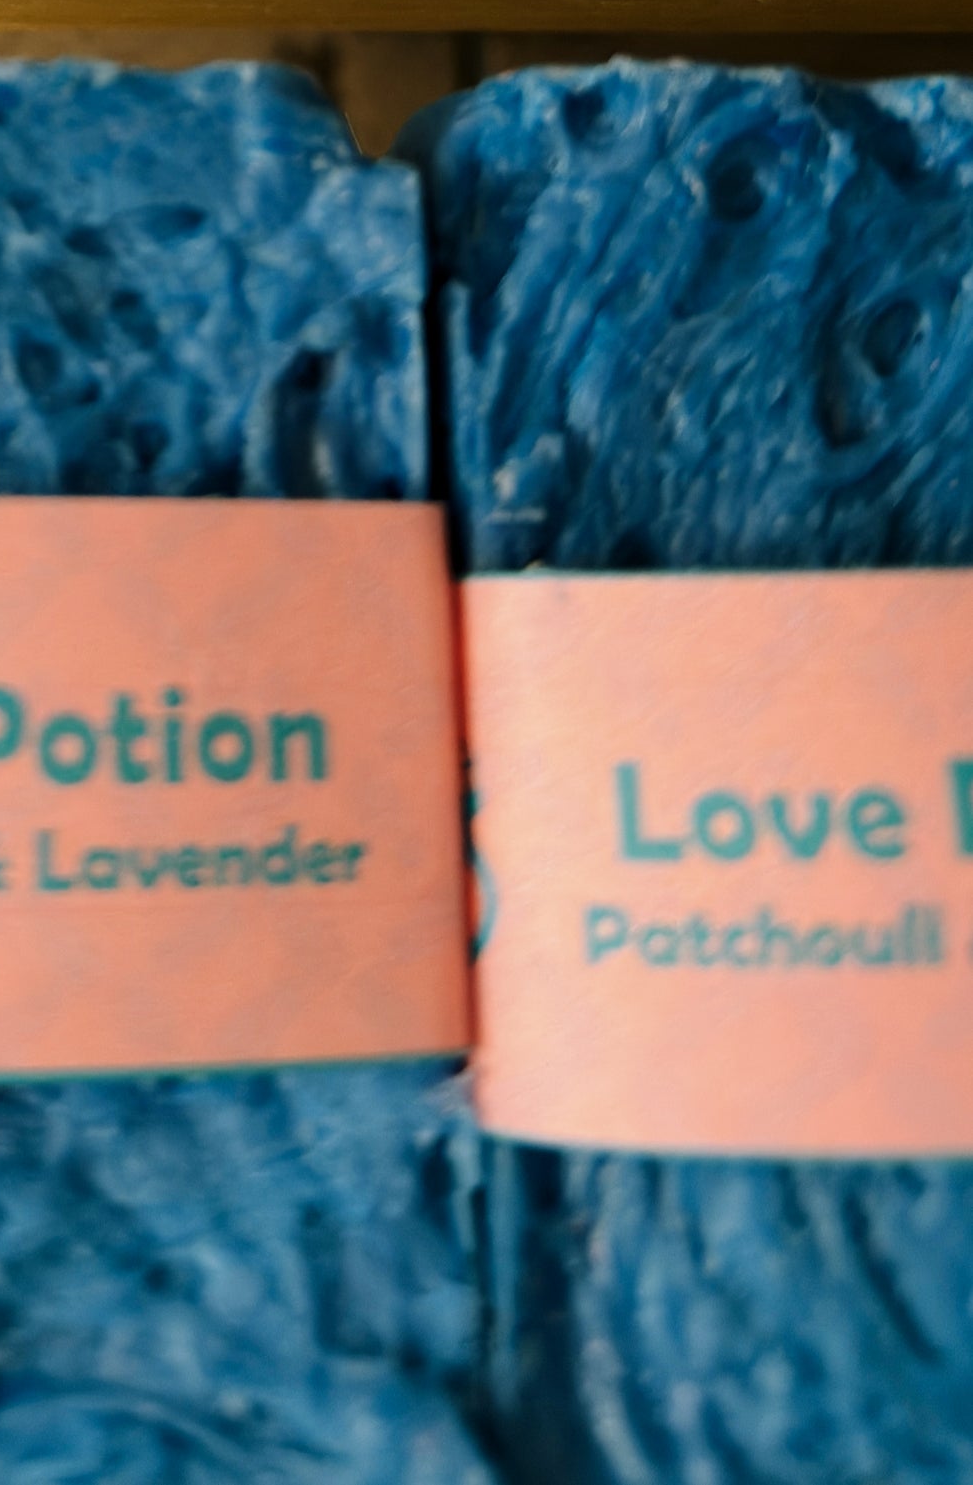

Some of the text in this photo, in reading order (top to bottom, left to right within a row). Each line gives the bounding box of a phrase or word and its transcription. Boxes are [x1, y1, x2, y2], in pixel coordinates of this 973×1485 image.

[613, 760, 907, 863] Love
[36, 823, 368, 893] Lavender
[583, 903, 945, 968] Patchouli
